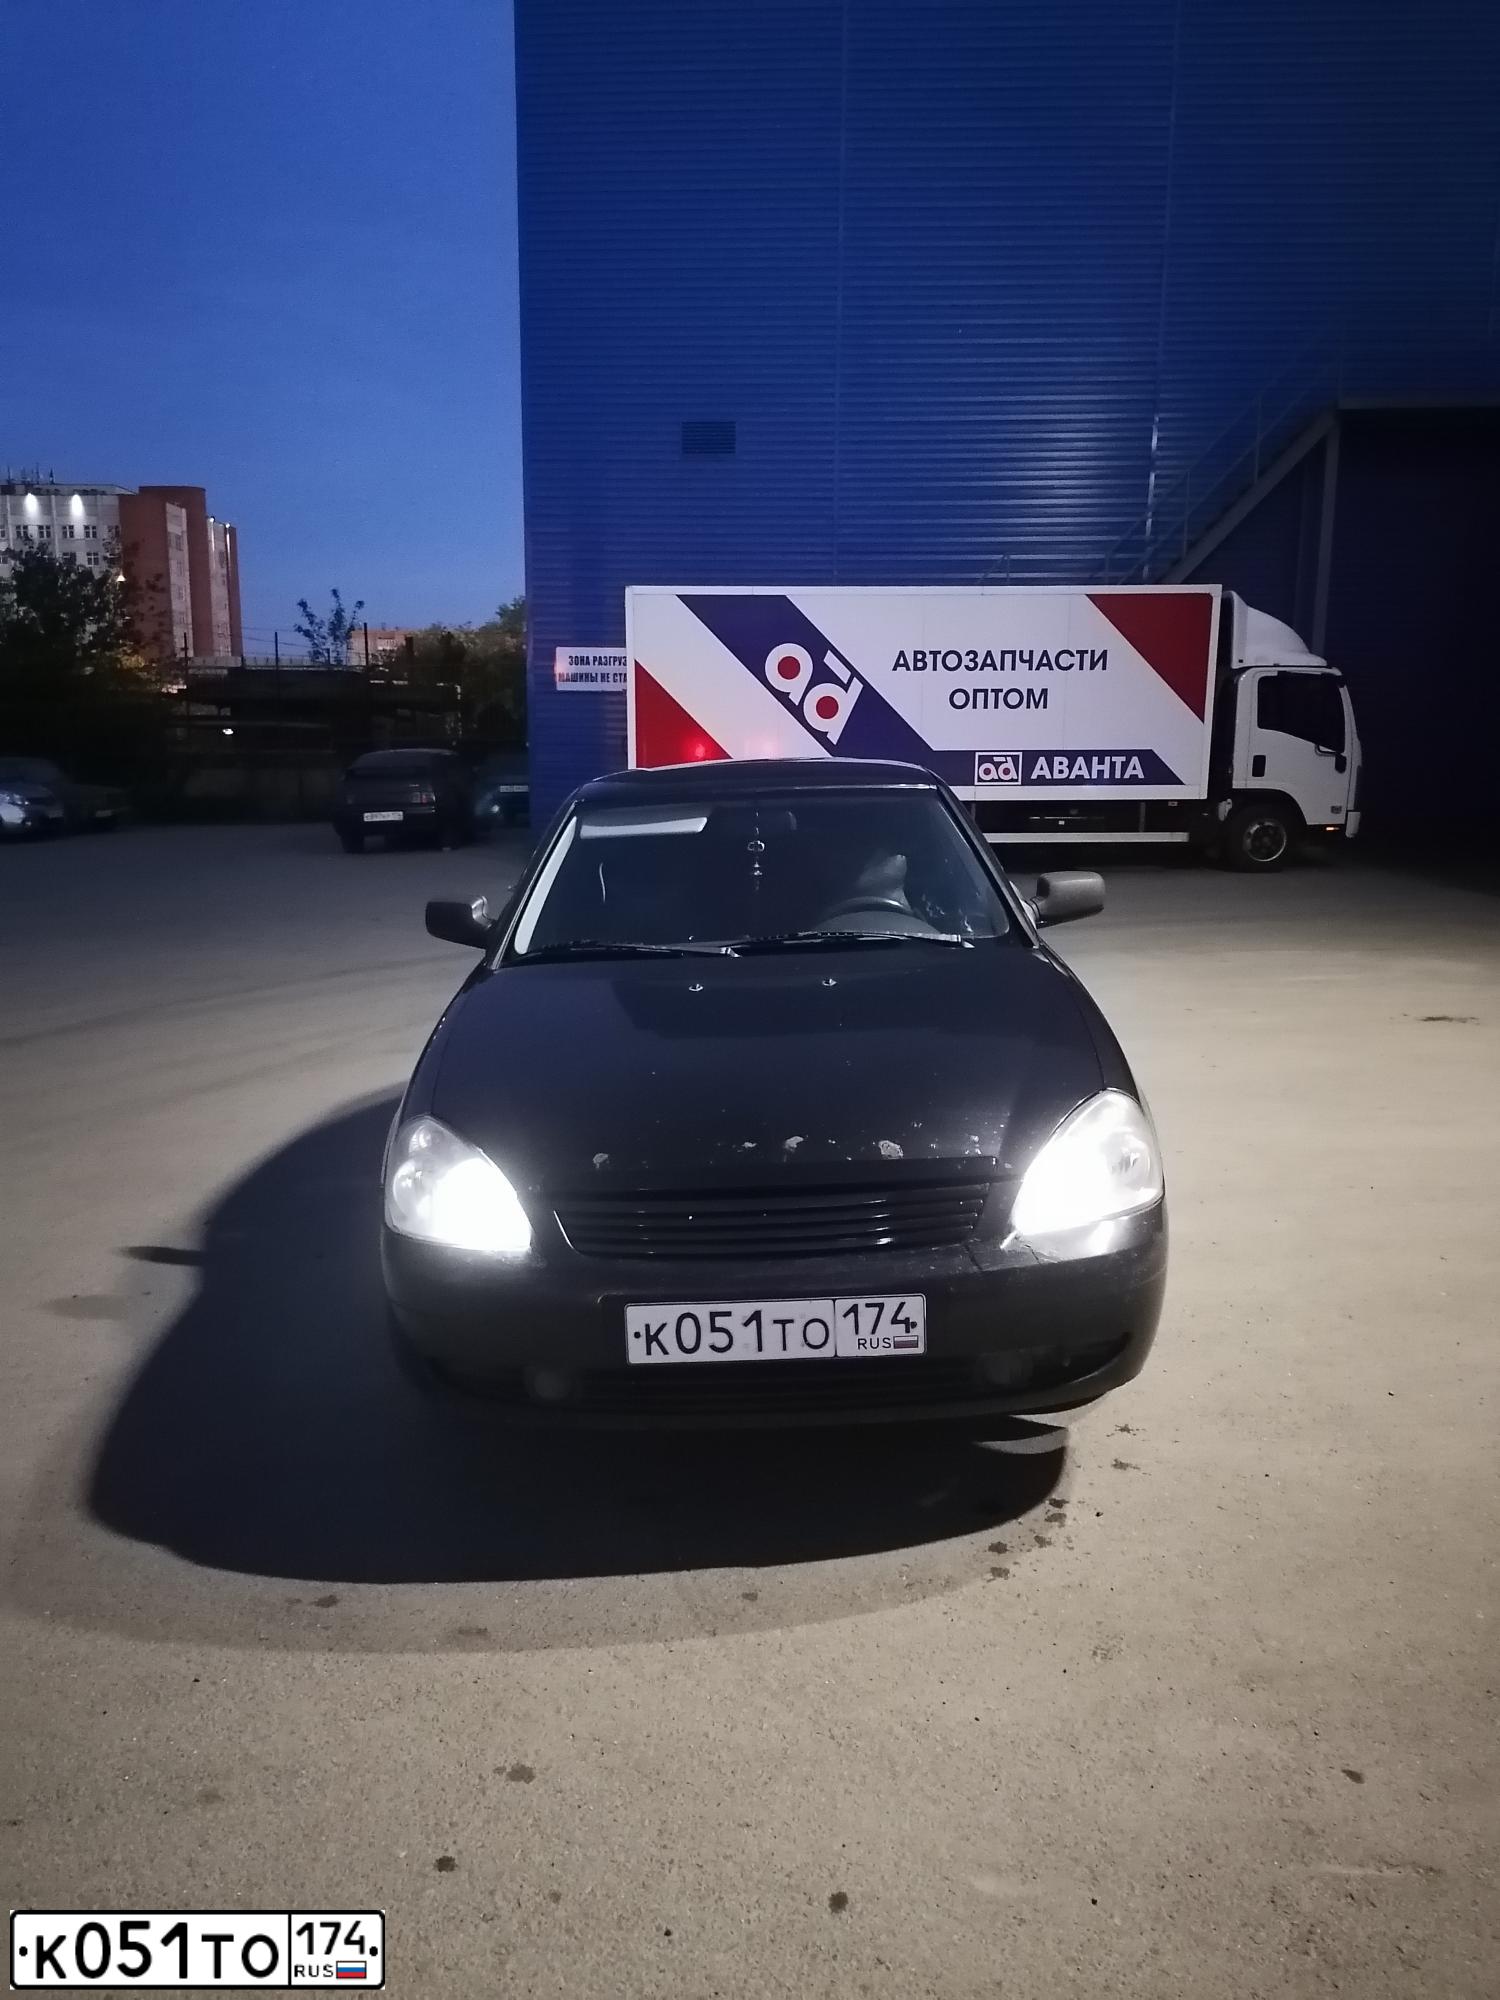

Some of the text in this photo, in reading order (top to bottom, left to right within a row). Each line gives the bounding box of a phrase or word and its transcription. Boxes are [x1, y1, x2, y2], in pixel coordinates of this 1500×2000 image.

[568, 655, 590, 666] ЗОНА
[892, 649, 1108, 672] АВТОЗАПЧАСТИ
[558, 672, 598, 683] МАШИНЫ
[601, 672, 610, 683] НЕ
[948, 687, 1048, 710] ОПТОМ
[1030, 756, 1145, 780] АВАНТА
[843, 1301, 911, 1335] 174
[857, 1337, 892, 1350] RUS
